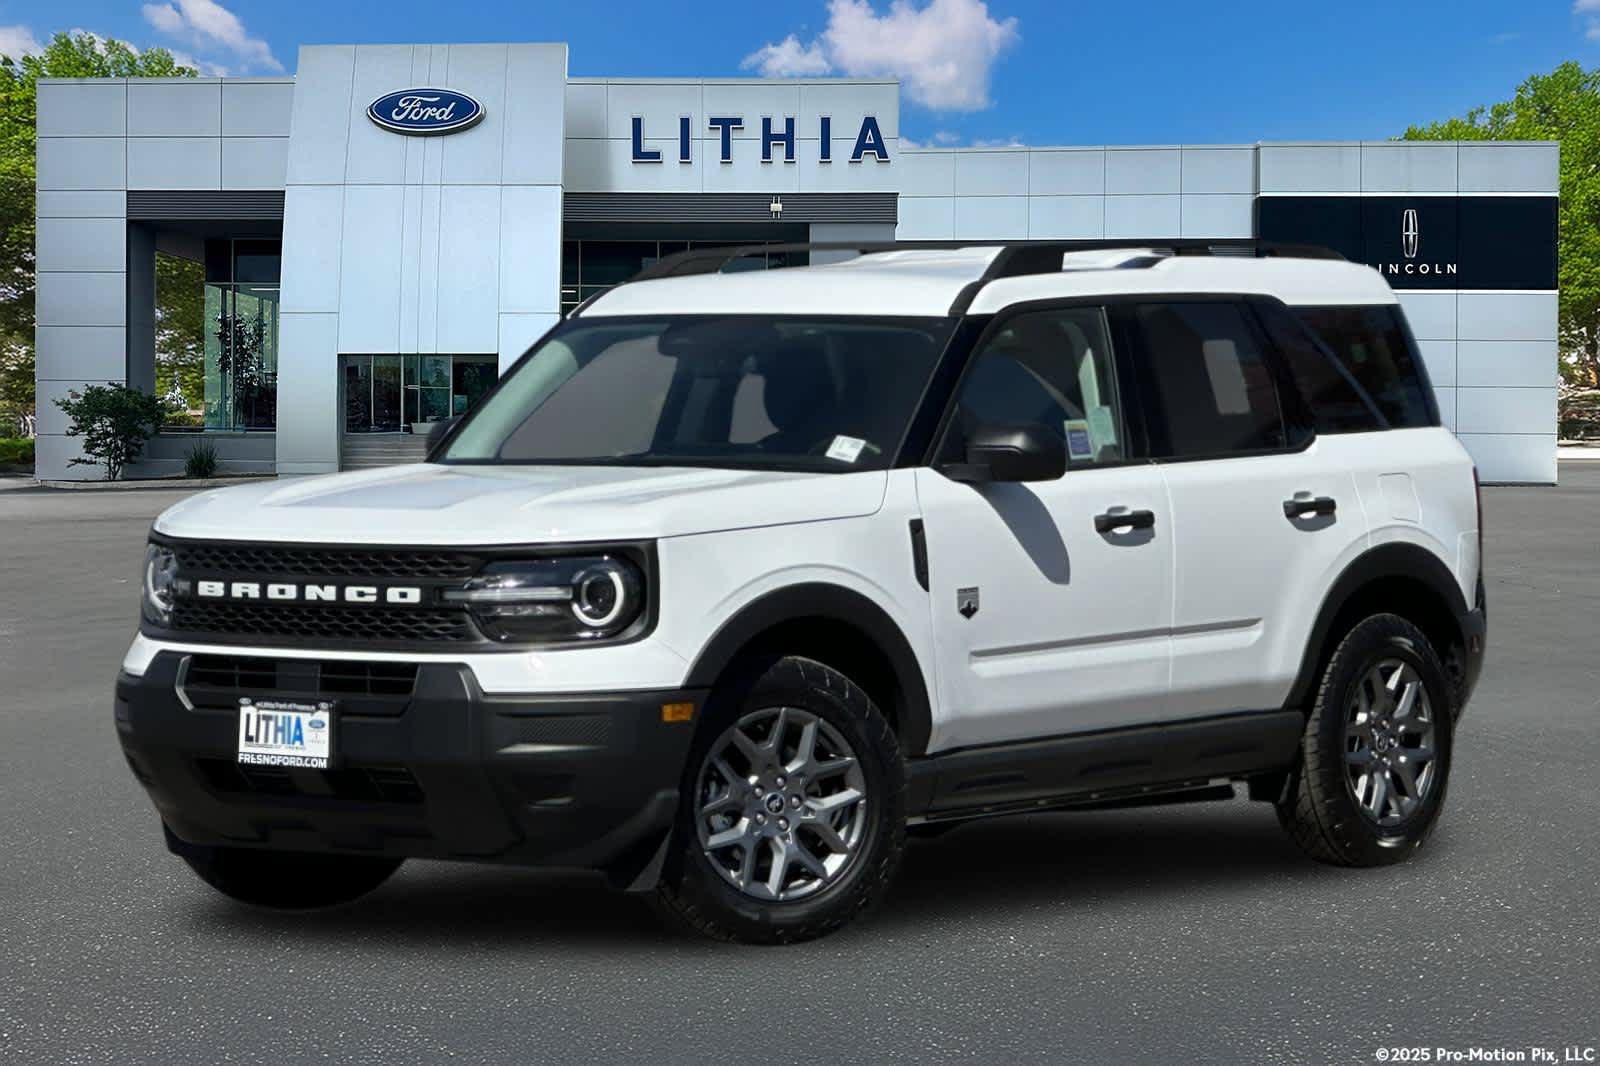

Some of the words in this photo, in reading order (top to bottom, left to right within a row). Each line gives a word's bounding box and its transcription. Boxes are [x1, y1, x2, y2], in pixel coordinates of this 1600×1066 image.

[391, 95, 456, 121] Ford
[631, 114, 891, 164] LITHIA
[1366, 263, 1457, 274] INCOLN
[197, 580, 421, 603] BRONCO
[244, 712, 305, 746] LITHIA
[238, 752, 328, 769] FRESNOFORD.COM
